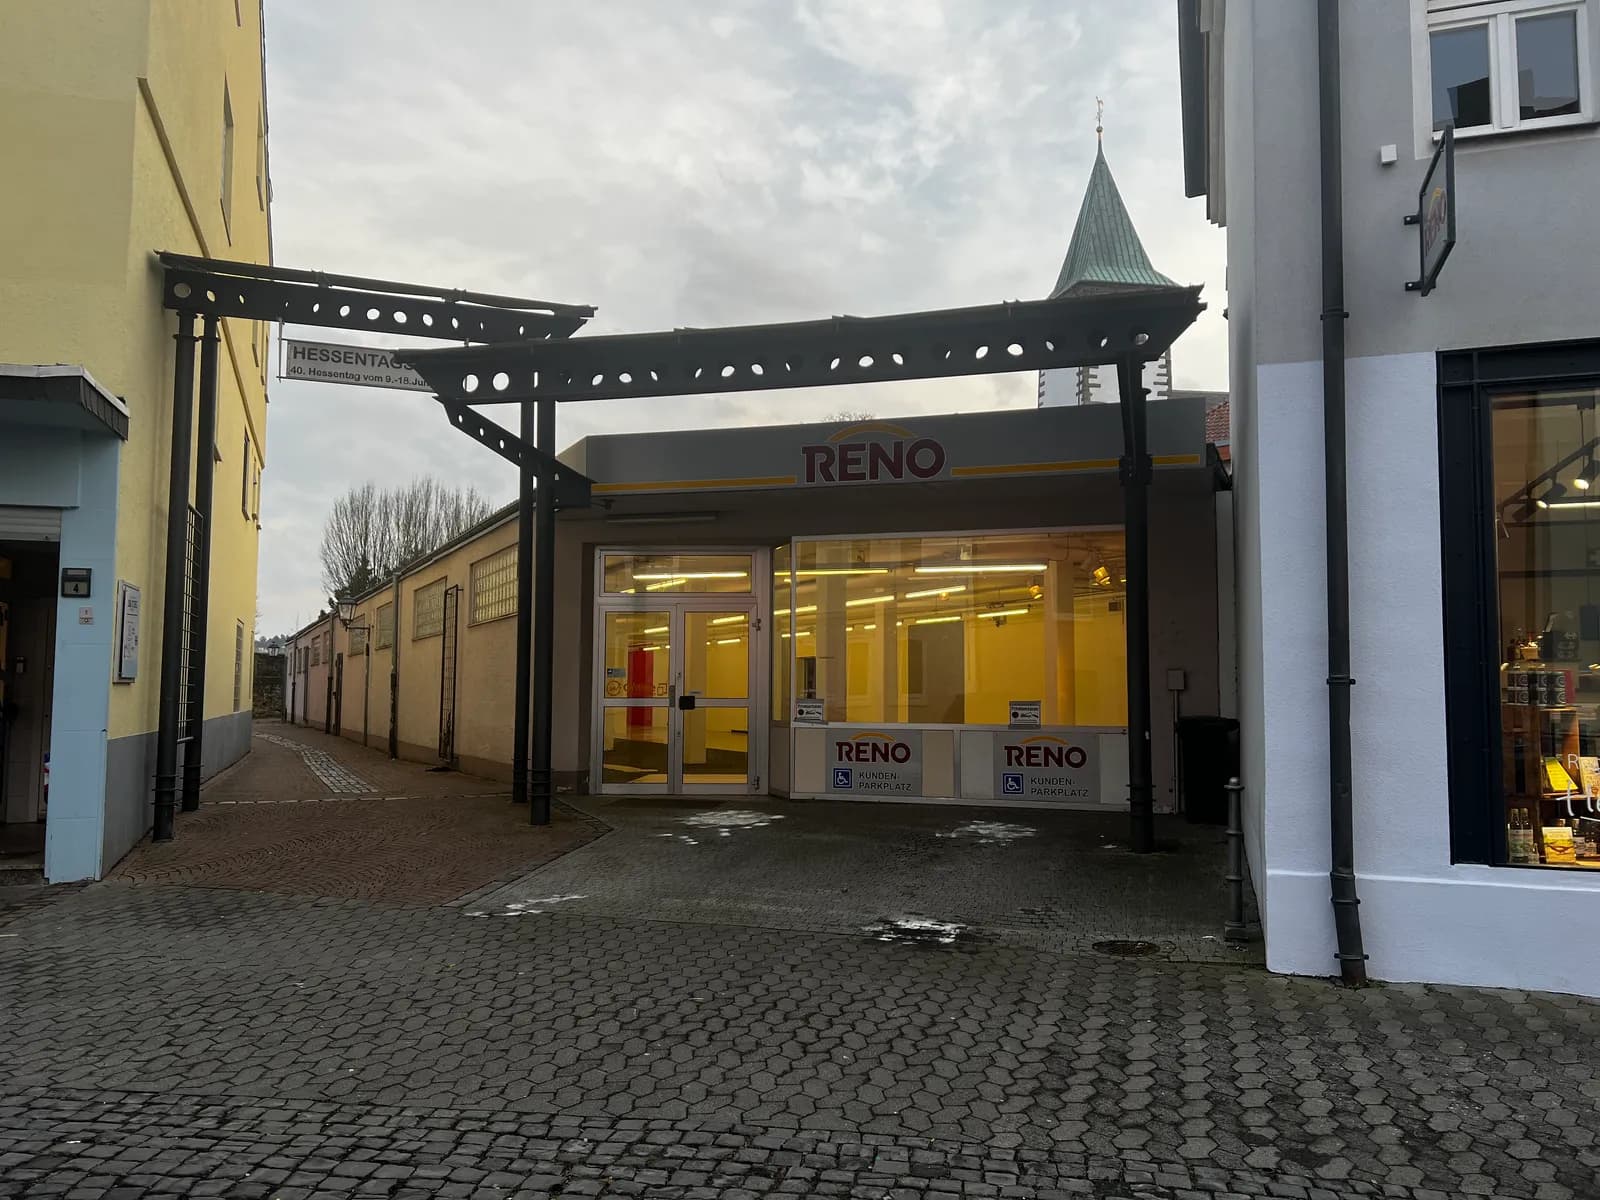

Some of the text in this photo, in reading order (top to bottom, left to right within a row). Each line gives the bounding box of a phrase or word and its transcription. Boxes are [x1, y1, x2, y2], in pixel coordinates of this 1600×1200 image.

[293, 346, 414, 370] HESSENTAG
[290, 366, 305, 375] 40.
[309, 367, 361, 381] Hessentag
[363, 373, 383, 383] vom
[801, 438, 946, 483] RENO
[73, 583, 79, 593] 4
[836, 742, 911, 763] RENO
[1004, 745, 1087, 768] RENO
[859, 782, 912, 791] PARKPLATZ
[1031, 788, 1088, 798] PARKPLATZ
